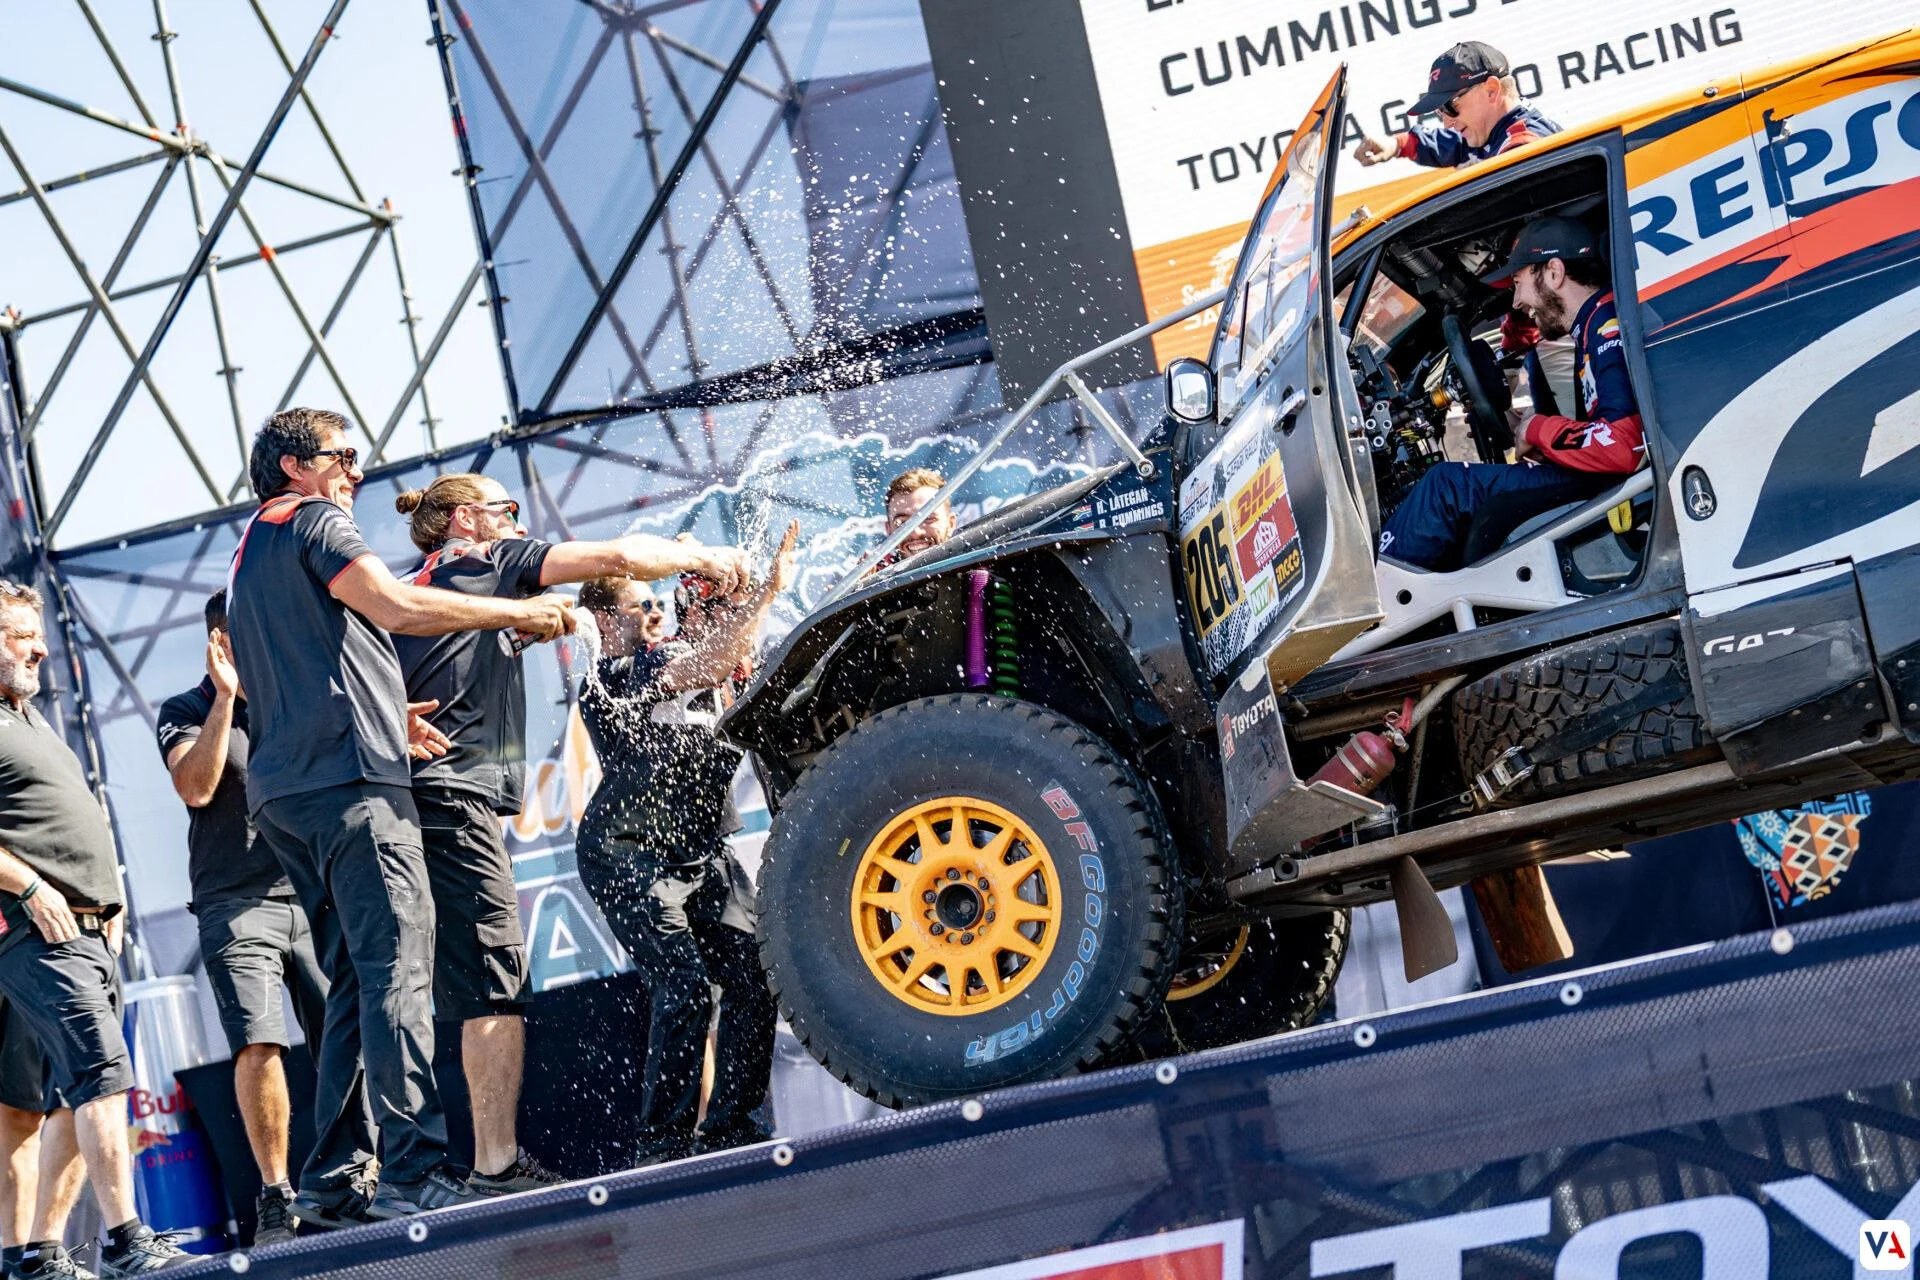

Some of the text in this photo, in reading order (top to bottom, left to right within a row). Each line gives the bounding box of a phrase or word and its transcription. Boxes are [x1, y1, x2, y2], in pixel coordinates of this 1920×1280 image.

[1557, 8, 1743, 89] RACING
[1096, 488, 1149, 515] H. LATEGAN
[1111, 502, 1165, 528] CUMMINGS
[1237, 466, 1277, 528] DHL
[1187, 510, 1240, 631] 205
[1231, 694, 1275, 738] TOYOTA
[965, 787, 1106, 1062] BFGoodrich
